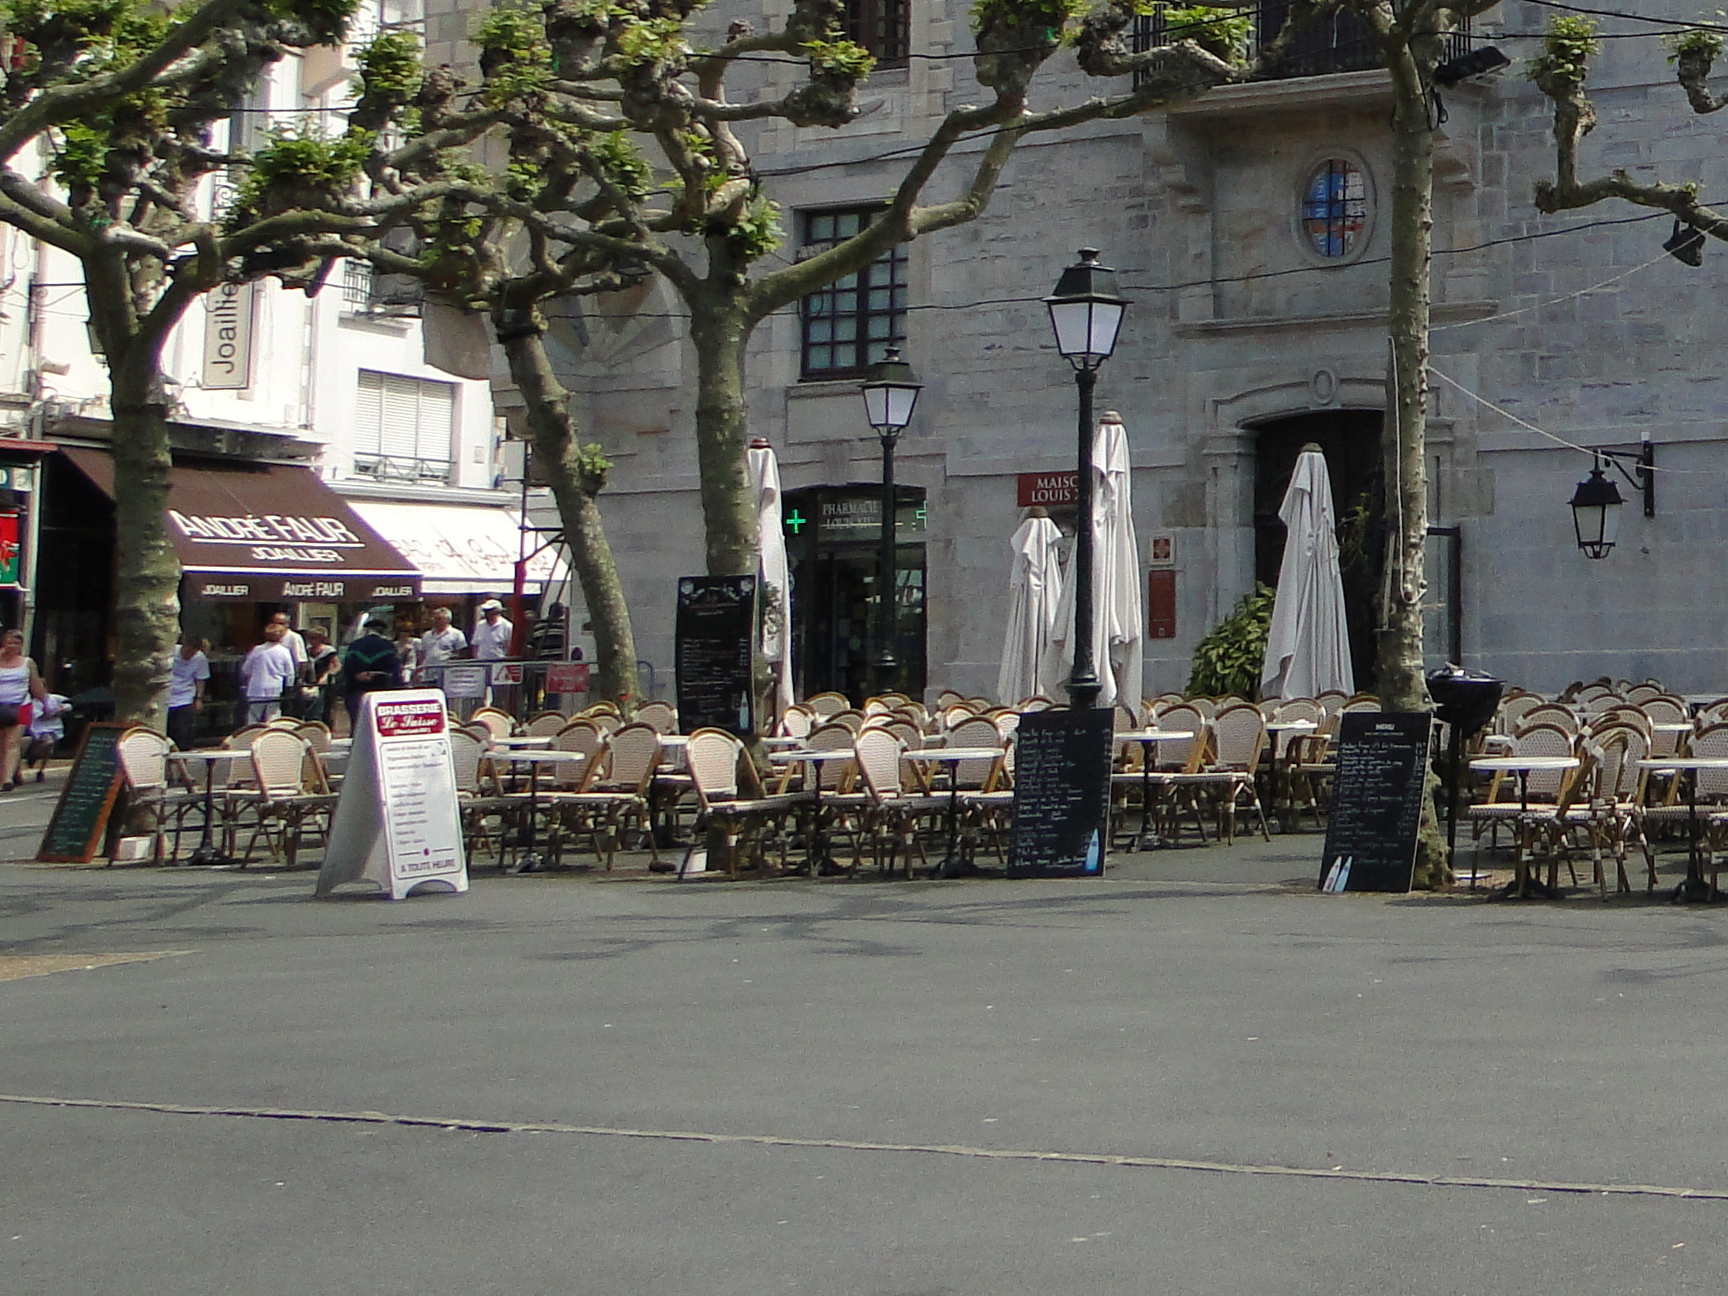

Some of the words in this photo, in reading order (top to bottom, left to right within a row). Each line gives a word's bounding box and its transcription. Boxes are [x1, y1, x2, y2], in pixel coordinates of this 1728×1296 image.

[210, 282, 239, 374] Joaillie
[1037, 475, 1079, 489] MAISO
[1031, 489, 1071, 503] LOUIS
[264, 515, 361, 543] FAUR
[252, 546, 345, 562] JOAILLIER
[202, 584, 249, 596] JOAILLIER
[315, 581, 345, 597] FAUR
[372, 585, 413, 597] JOAILLIER
[377, 703, 442, 717] BRASSERIE
